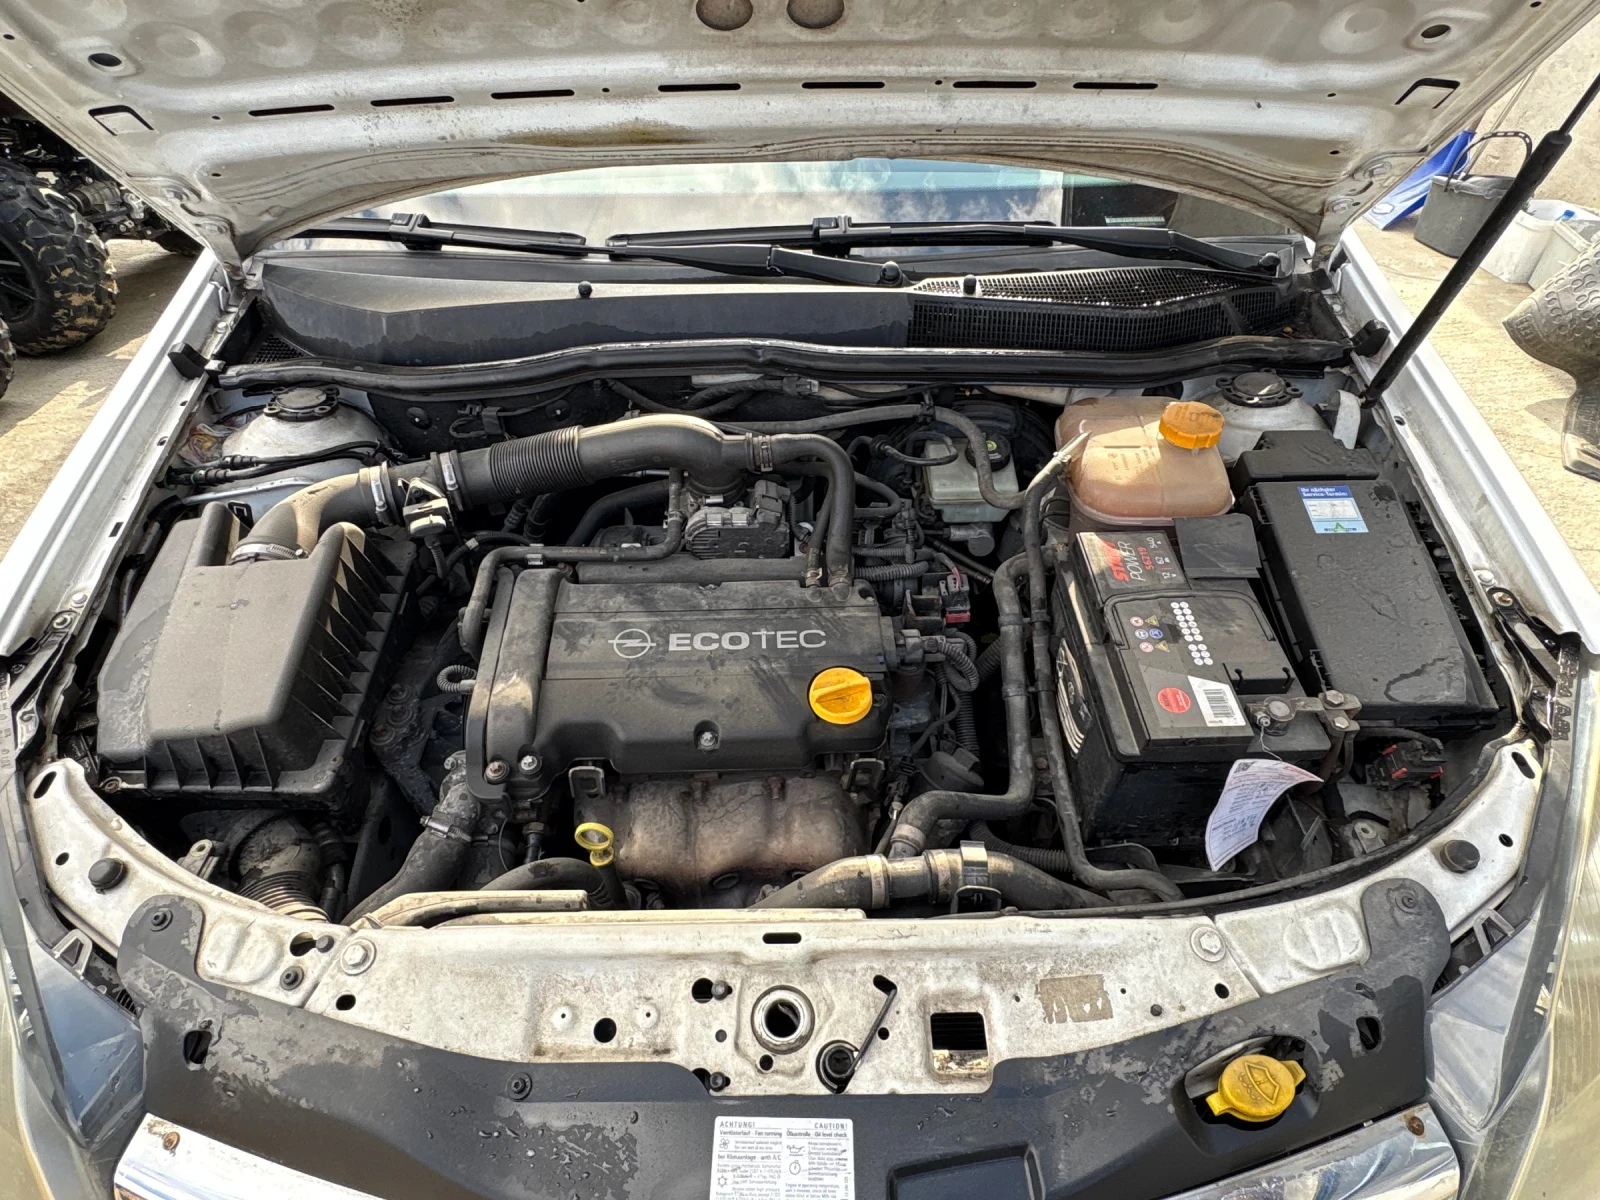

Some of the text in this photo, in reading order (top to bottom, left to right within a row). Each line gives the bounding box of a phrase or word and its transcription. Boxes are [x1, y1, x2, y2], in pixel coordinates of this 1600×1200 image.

[1147, 537, 1157, 549] 540
[1117, 541, 1146, 581] POWER
[1137, 546, 1154, 570] 56219
[1155, 556, 1164, 565] 62
[668, 629, 826, 651] ECOTEC
